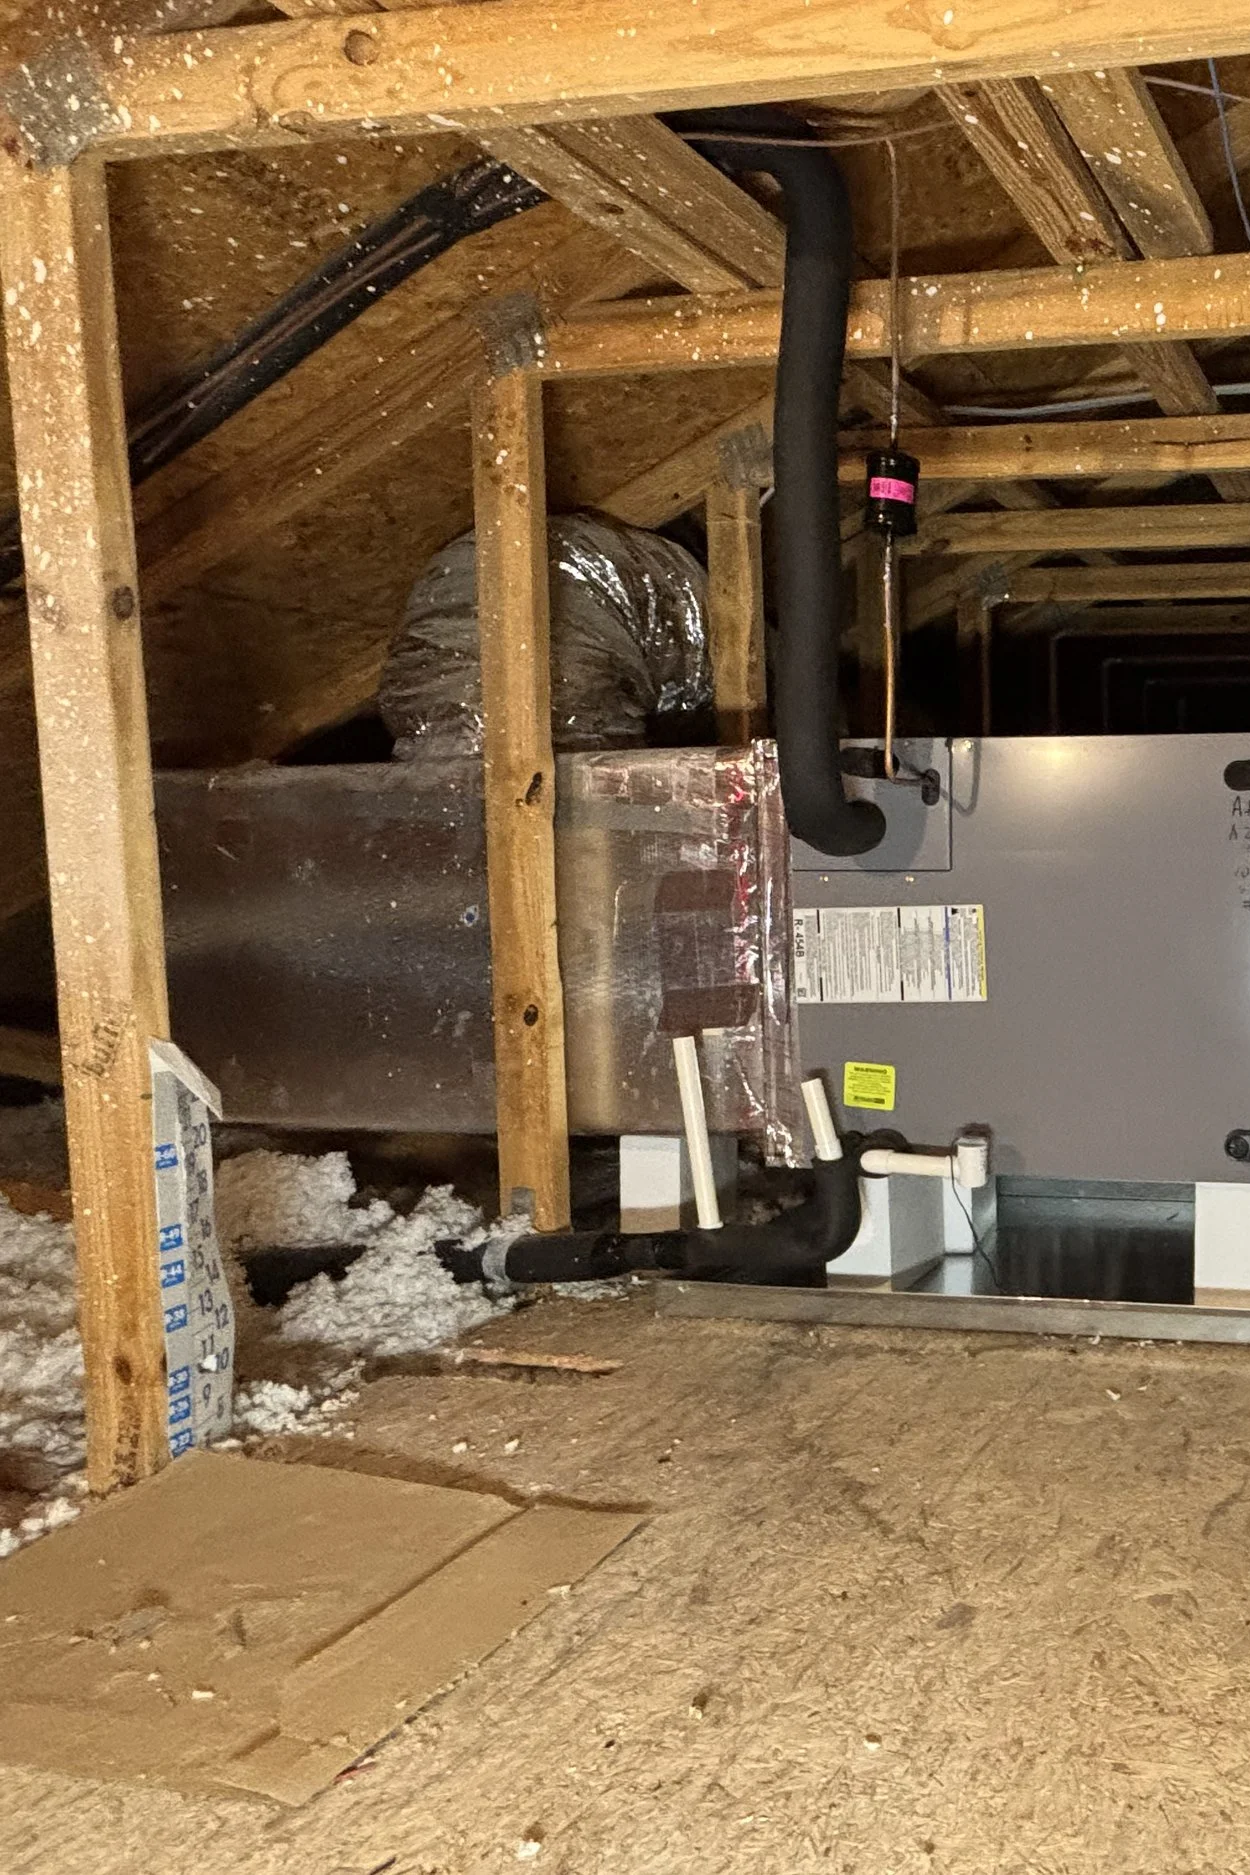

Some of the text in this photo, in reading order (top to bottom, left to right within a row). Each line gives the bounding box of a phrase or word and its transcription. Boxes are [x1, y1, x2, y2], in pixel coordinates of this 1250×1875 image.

[793, 918, 805, 958] R-454B
[199, 1288, 214, 1316] 13
[214, 1303, 230, 1330] 12
